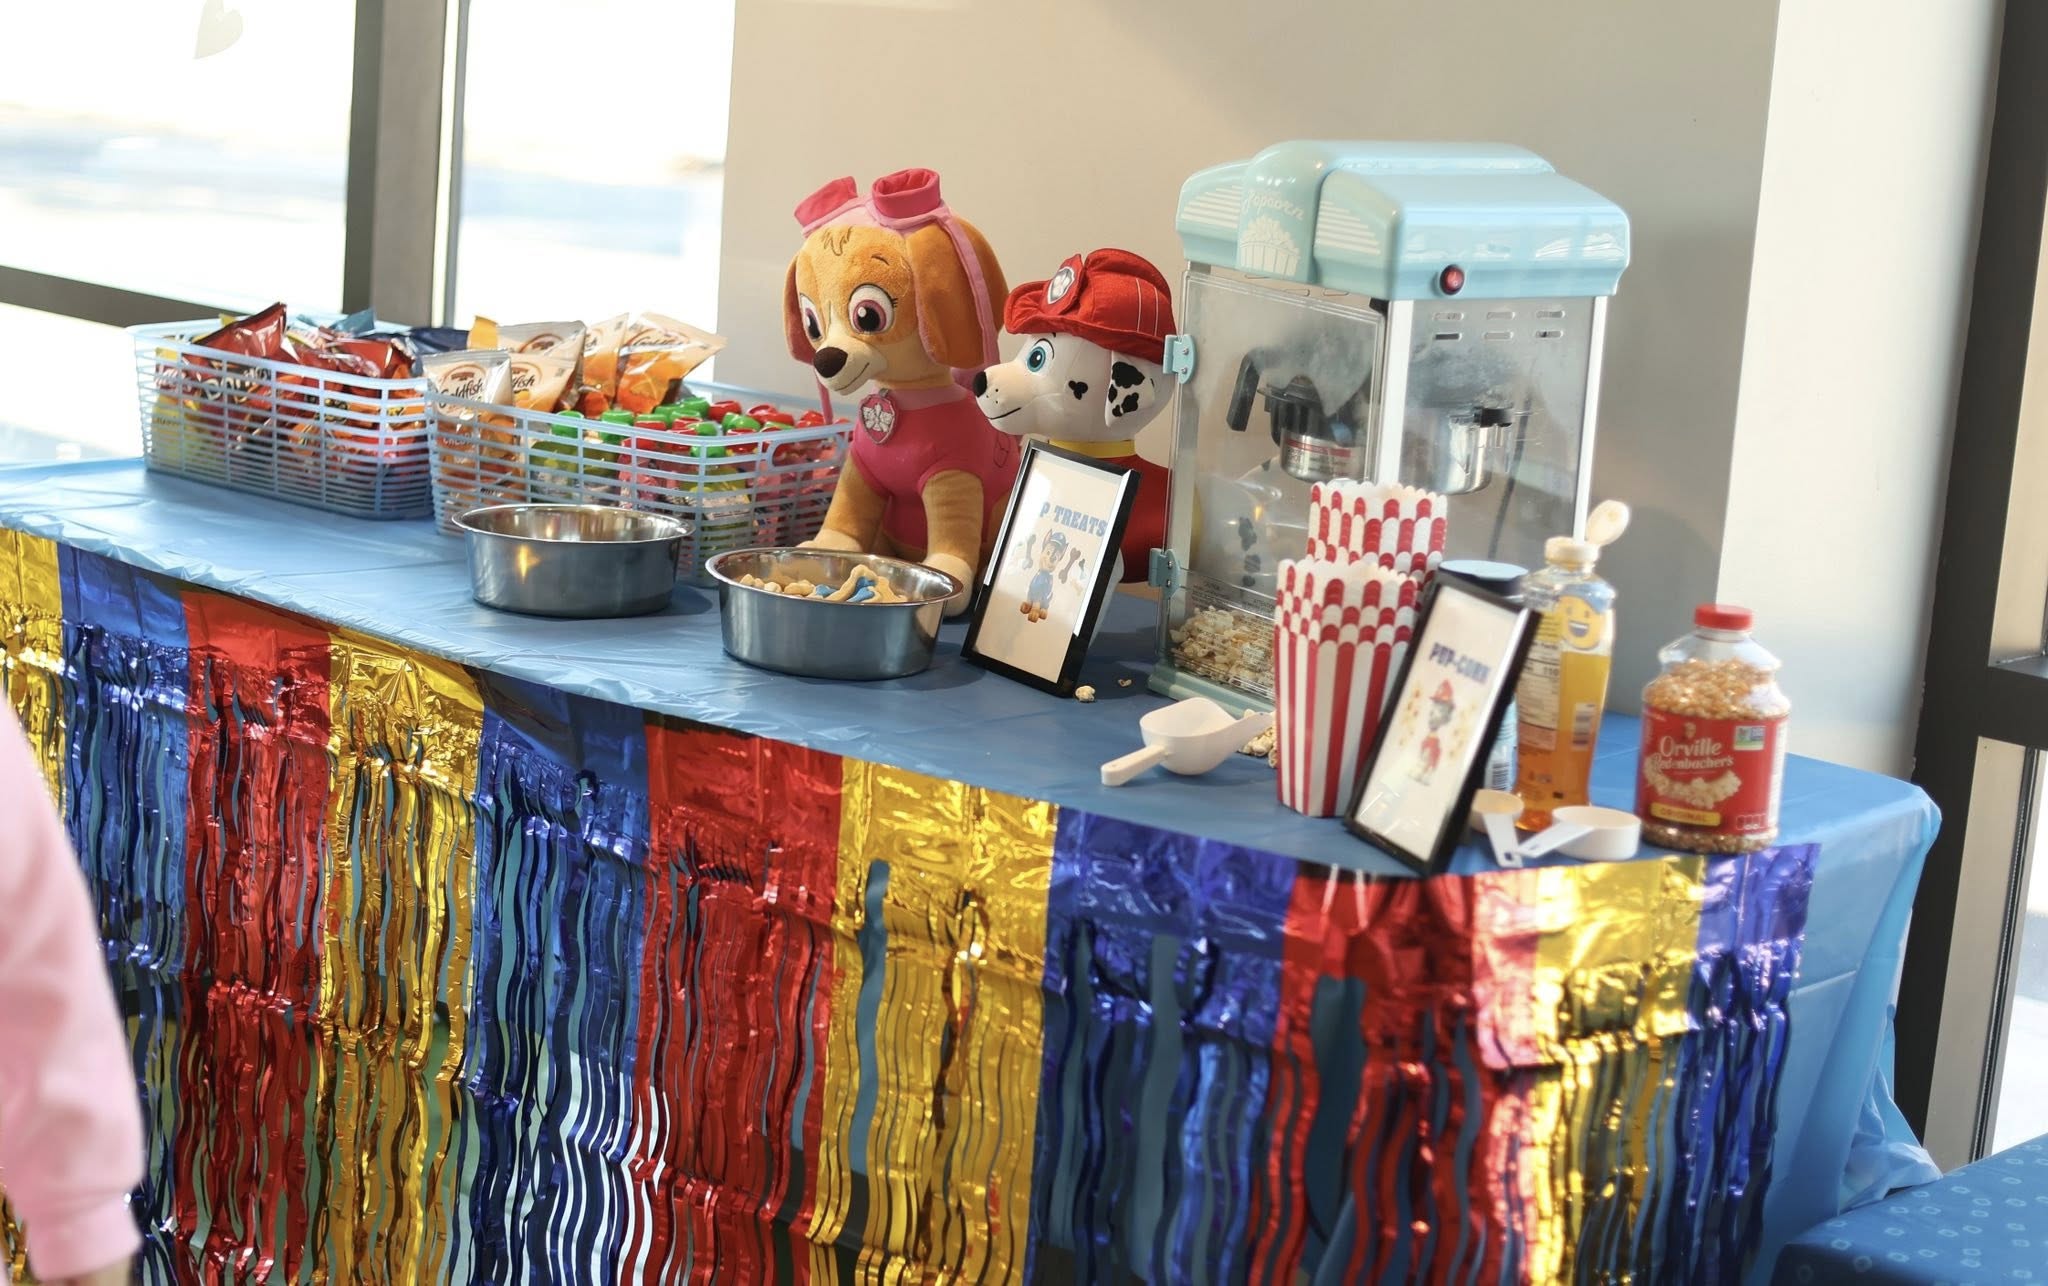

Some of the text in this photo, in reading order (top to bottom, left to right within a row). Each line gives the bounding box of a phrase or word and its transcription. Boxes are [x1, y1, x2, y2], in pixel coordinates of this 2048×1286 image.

[440, 379, 483, 408] Gldfish
[1053, 505, 1108, 537] TREATS
[1660, 735, 1721, 757] Orville
